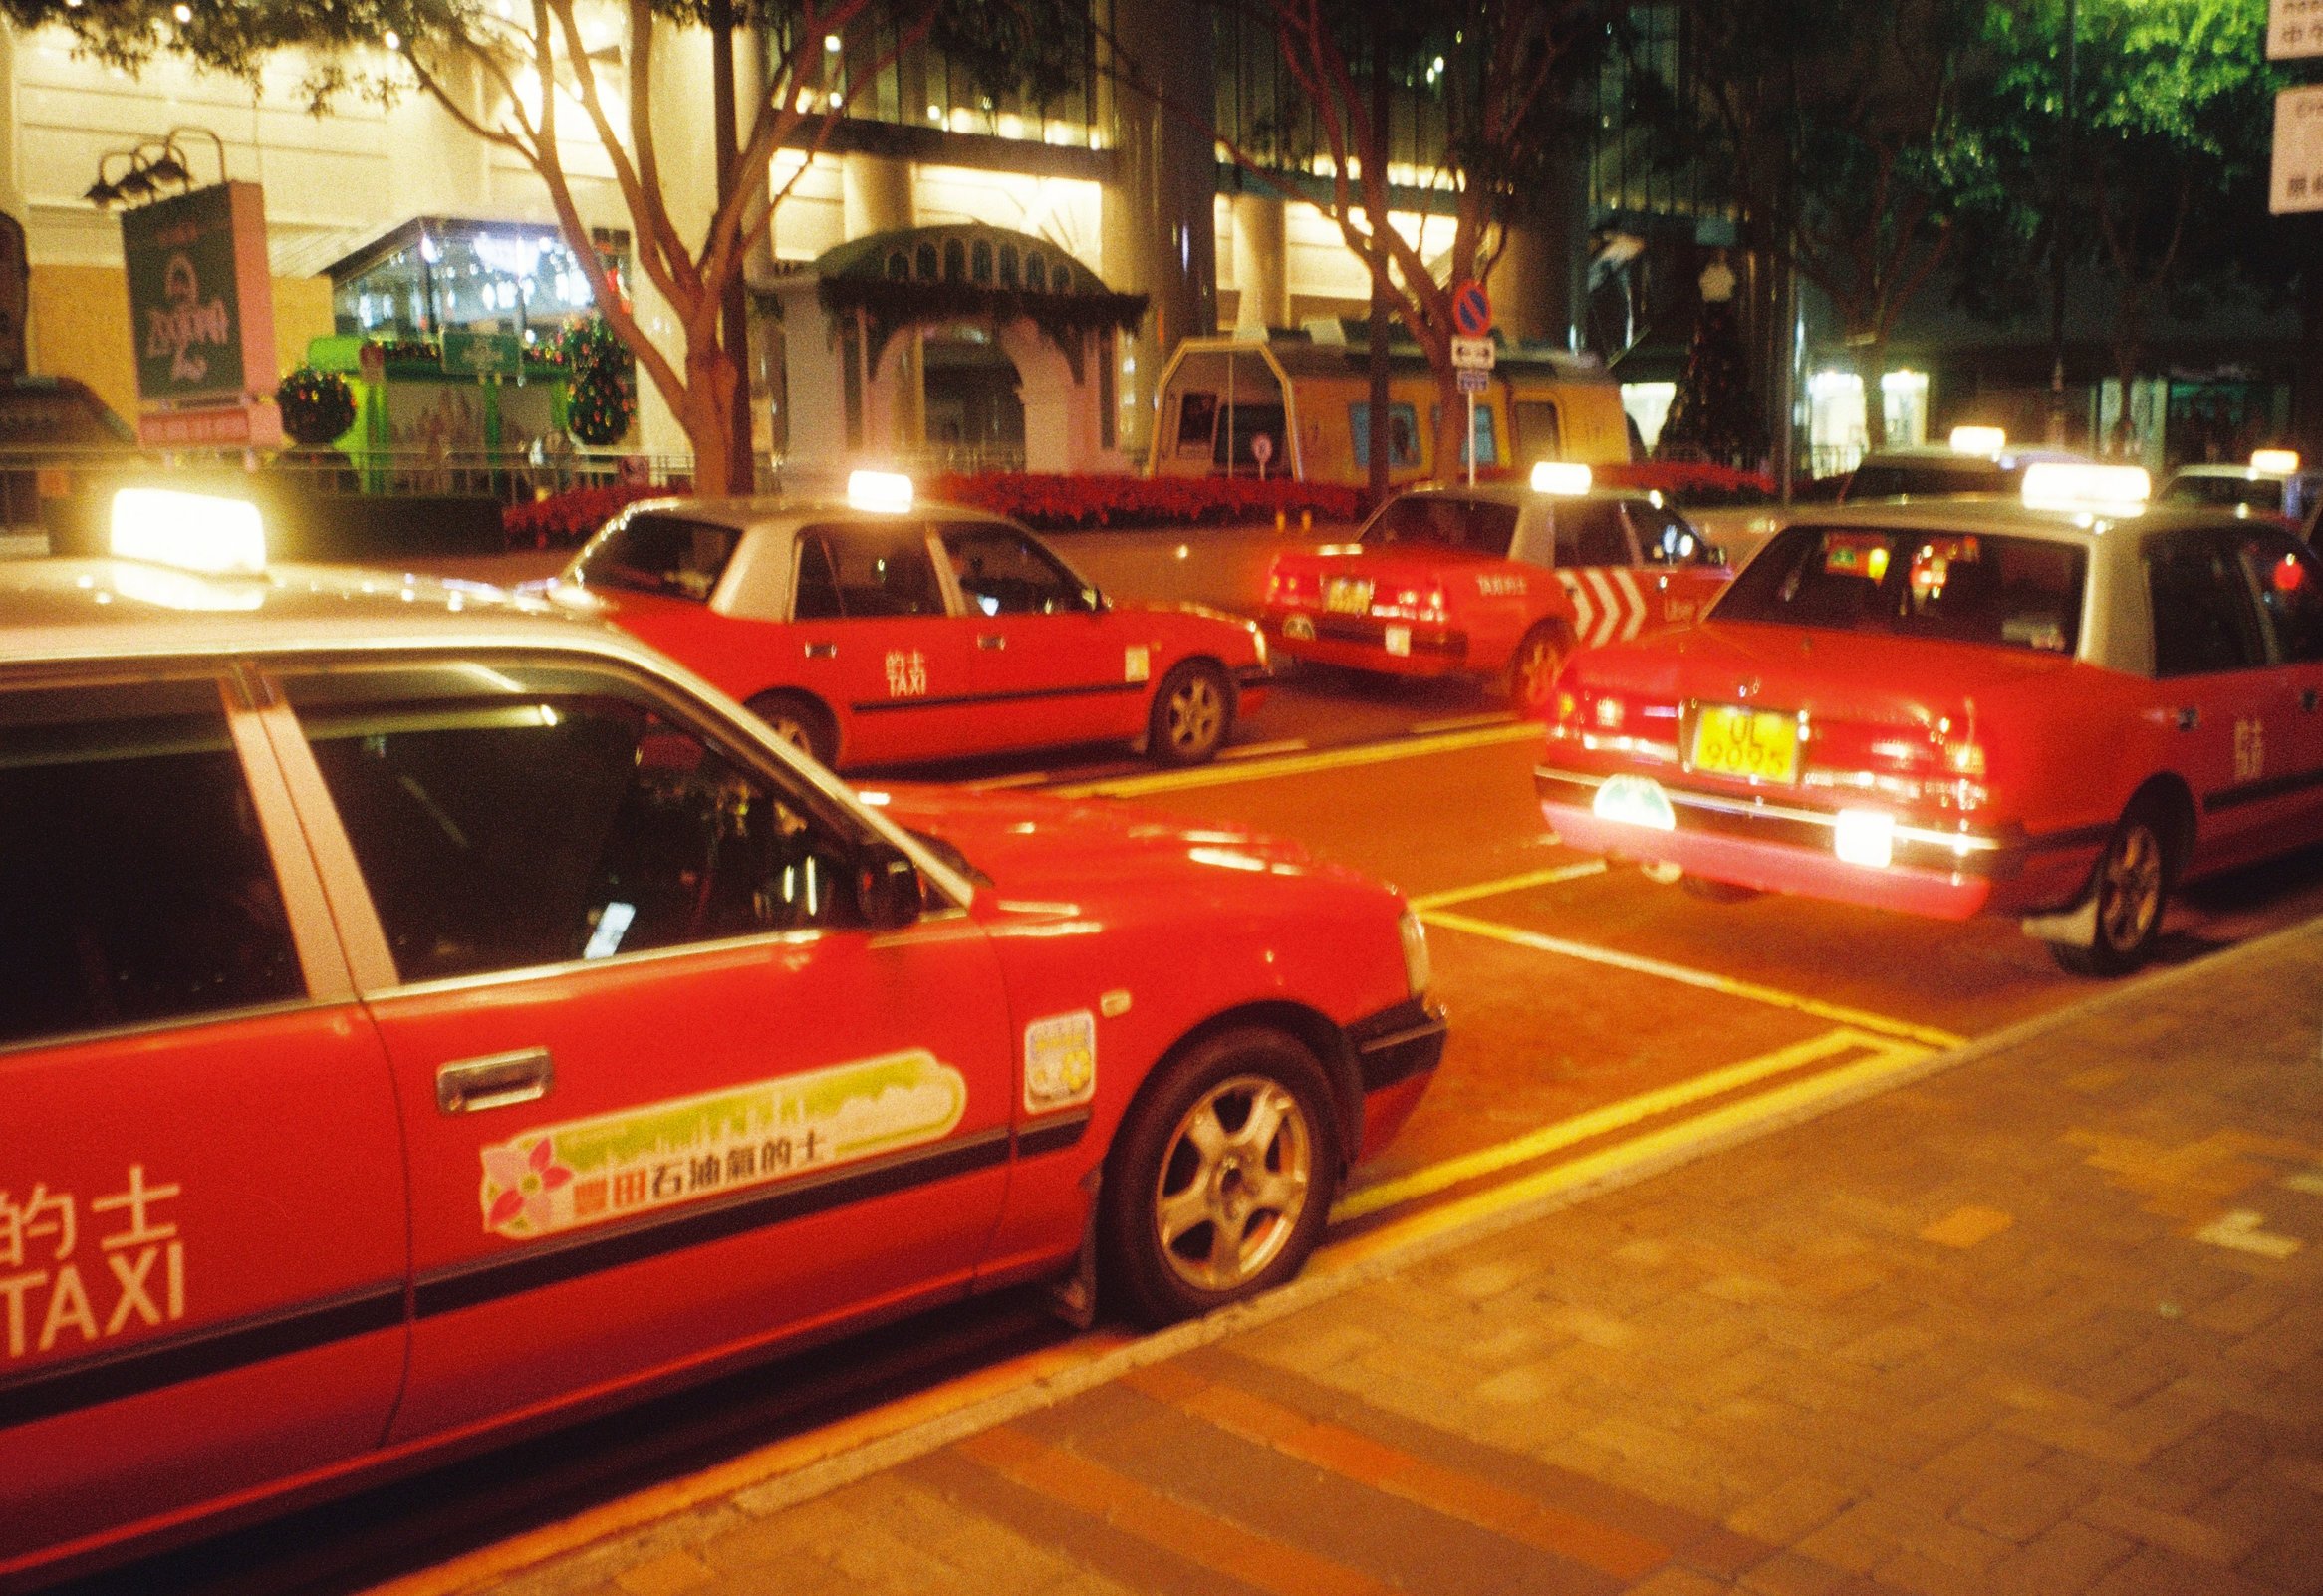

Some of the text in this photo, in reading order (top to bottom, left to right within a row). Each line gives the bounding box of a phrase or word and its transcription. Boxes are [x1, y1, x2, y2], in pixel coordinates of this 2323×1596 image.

[887, 668, 926, 697] TAXI
[1729, 711, 1765, 749] UL
[0, 1163, 180, 1266] 的士
[0, 1241, 184, 1359] TAXI
